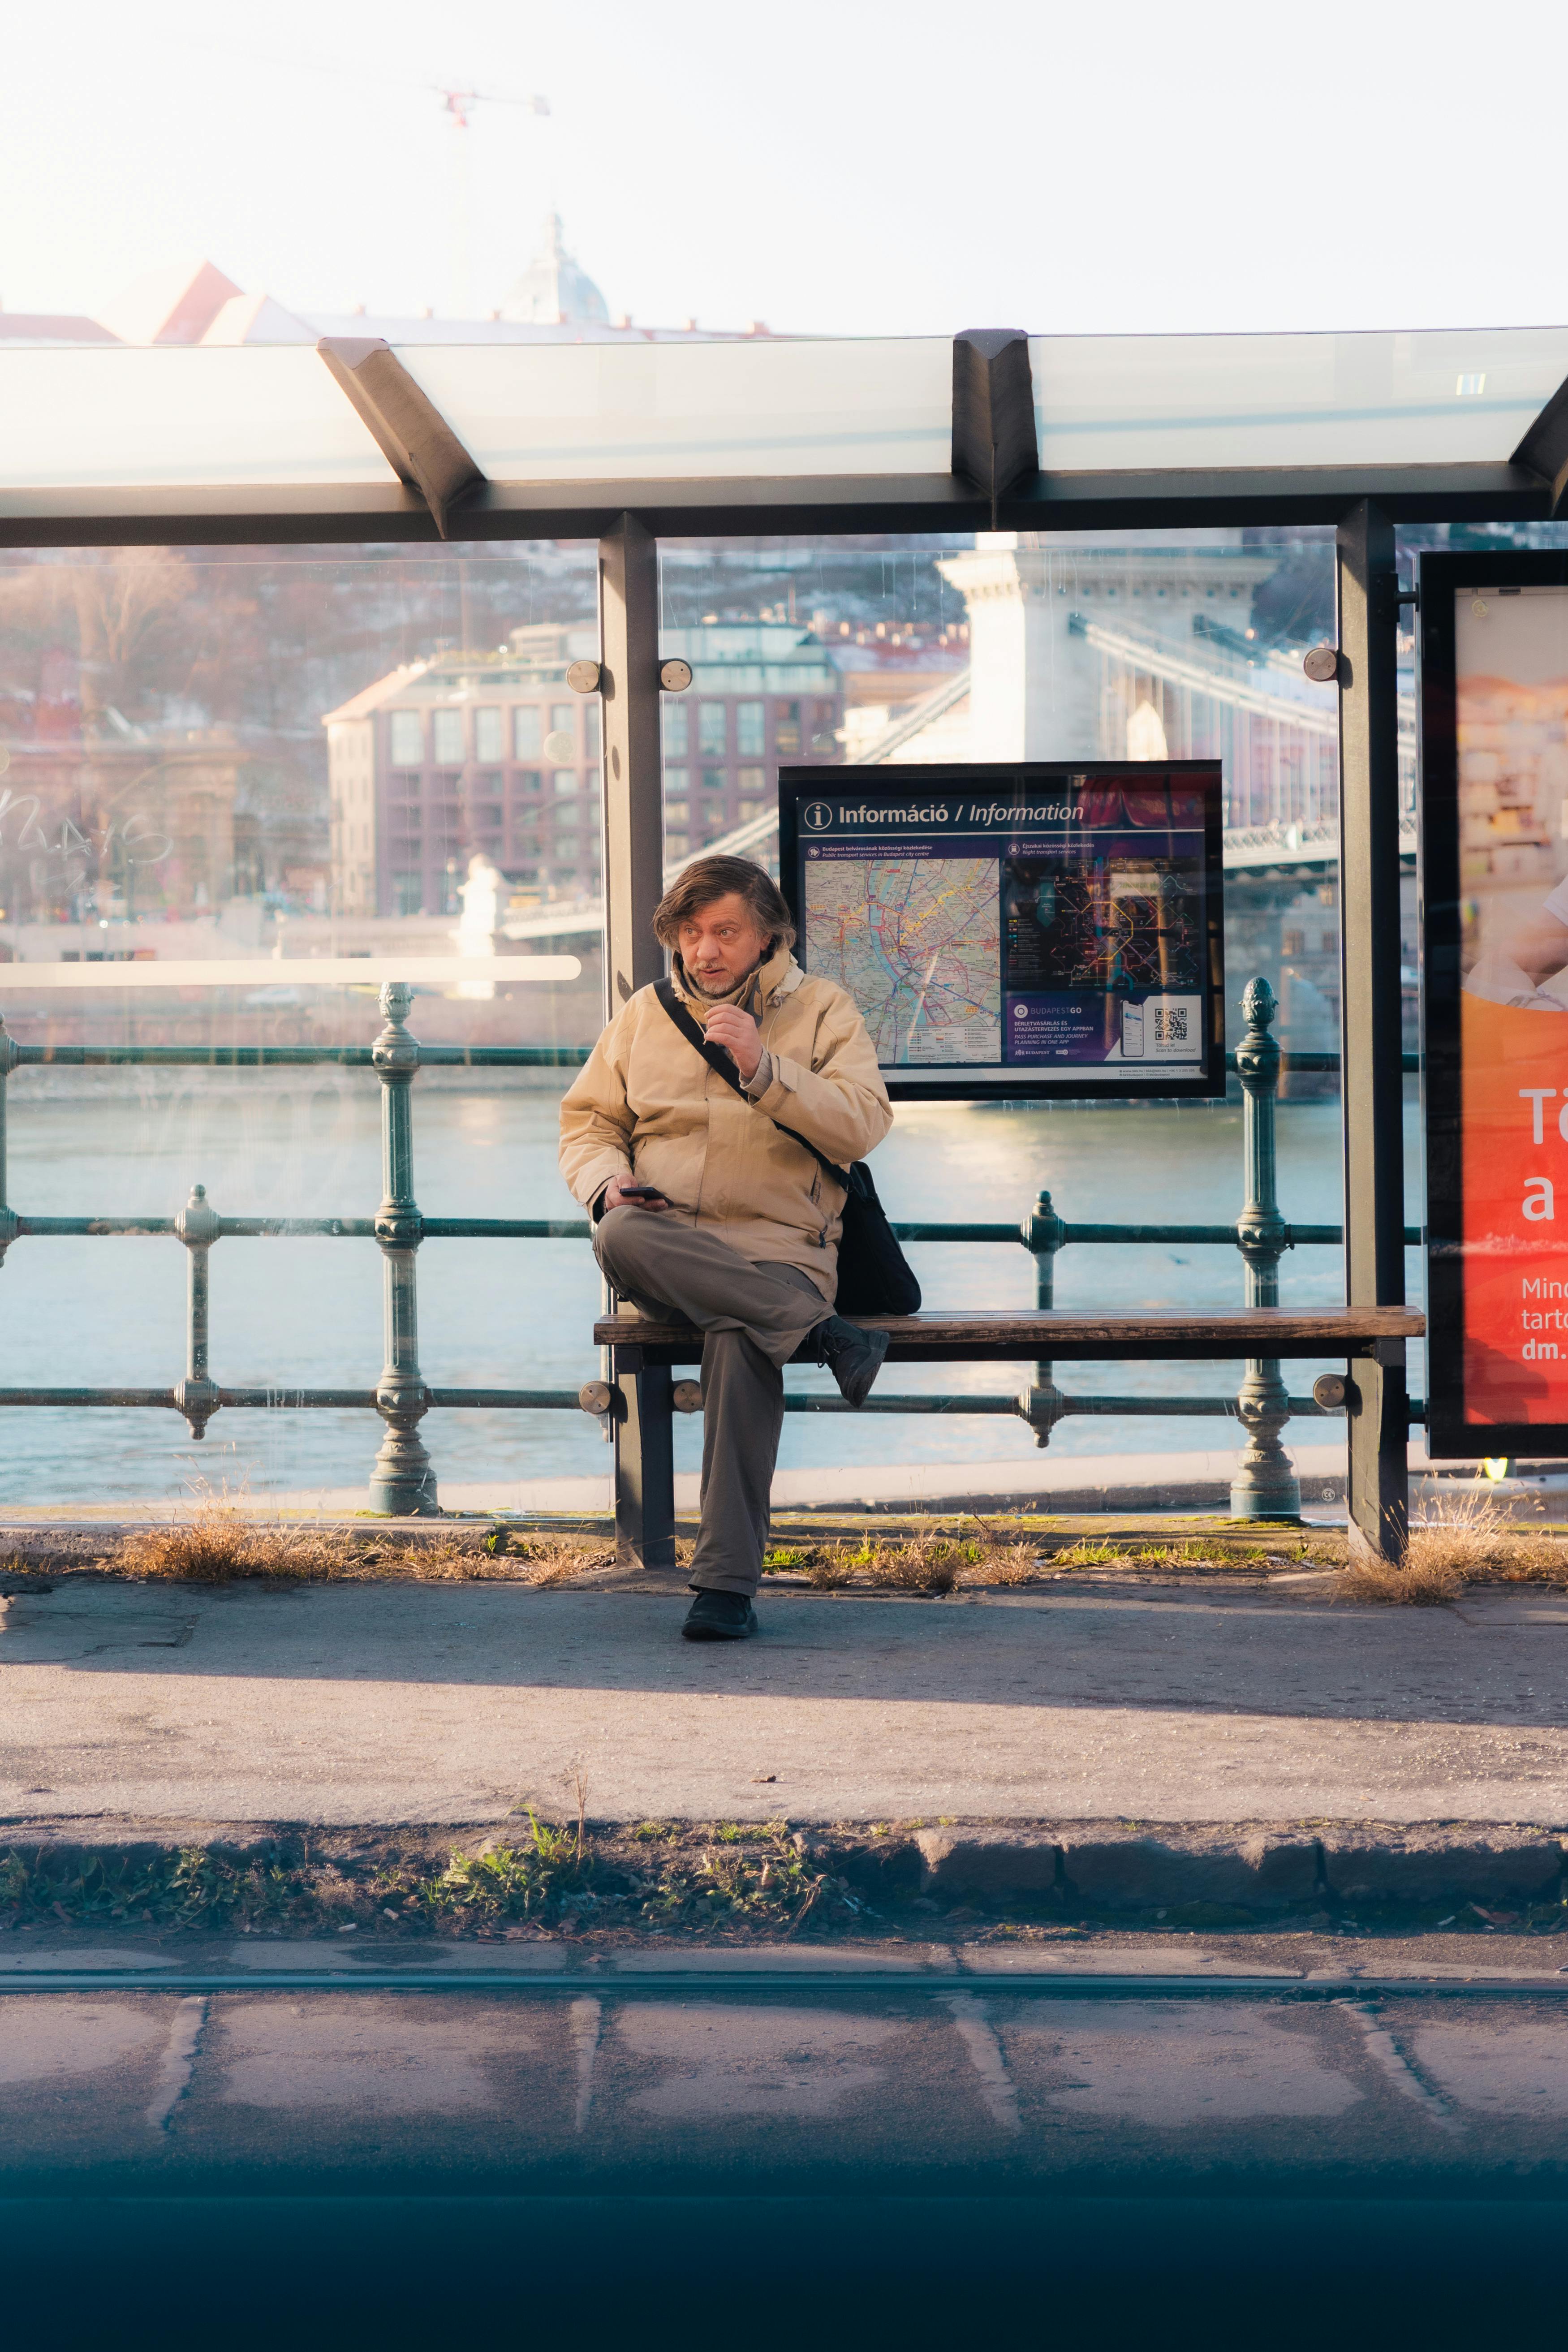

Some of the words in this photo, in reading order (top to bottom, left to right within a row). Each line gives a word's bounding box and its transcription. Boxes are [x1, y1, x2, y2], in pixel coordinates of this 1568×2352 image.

[840, 804, 949, 823] Információ
[969, 802, 1084, 826] Information
[1519, 1088, 1568, 1145] T
[1522, 1176, 1555, 1221] a
[1522, 1338, 1567, 1360] dm.
